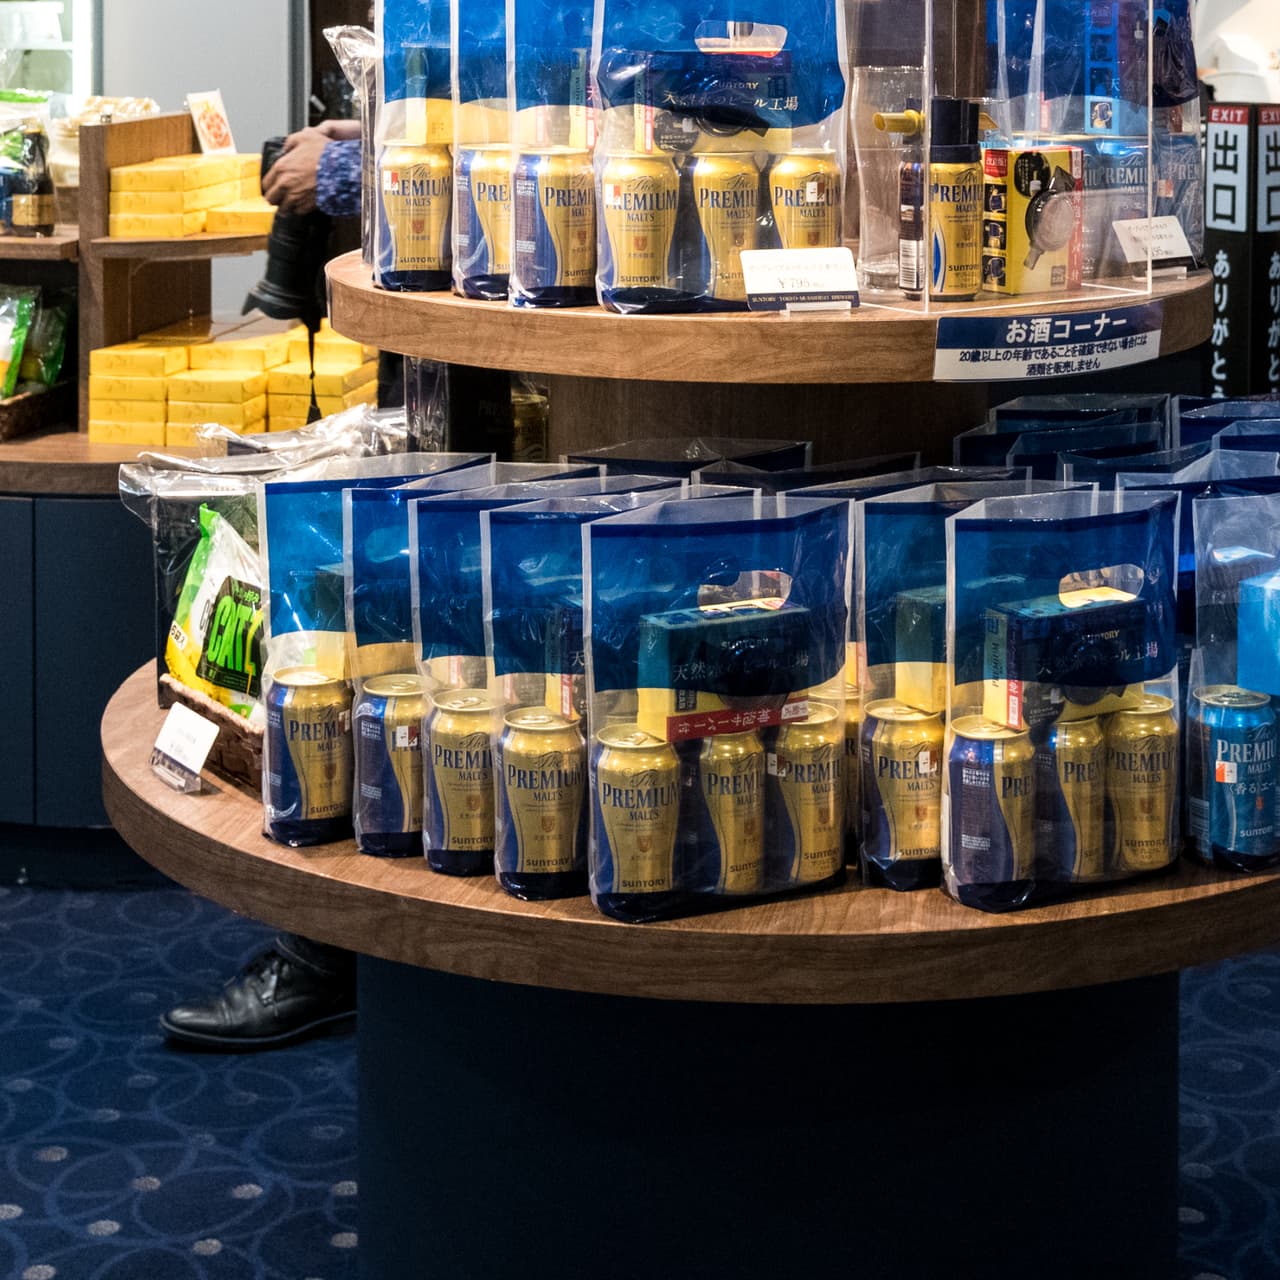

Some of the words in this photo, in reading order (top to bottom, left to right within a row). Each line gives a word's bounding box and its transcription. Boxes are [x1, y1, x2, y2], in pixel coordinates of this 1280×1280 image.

[1211, 108, 1246, 122] EXIT
[1212, 130, 1239, 224] 出口
[384, 176, 452, 196] REMIUM
[405, 198, 432, 208] MALTS
[626, 212, 655, 222] MALTS
[726, 209, 752, 219] MALTS
[800, 209, 825, 218] MALTS
[620, 275, 661, 283] SUNTORY
[1006, 313, 1128, 344] お酒コーナー
[959, 334, 1148, 362] 20歳以上の年齢であることを確認できない場合には
[1026, 358, 1101, 377] 酒類を販売しません
[459, 770, 489, 780] MALTS
[1132, 773, 1161, 784] MALTS
[907, 781, 936, 792] MALTS
[533, 791, 563, 801] MALTS
[629, 810, 659, 821] MALTS
[526, 857, 570, 867] SUNTORY
[622, 879, 666, 888] SUNTORY
